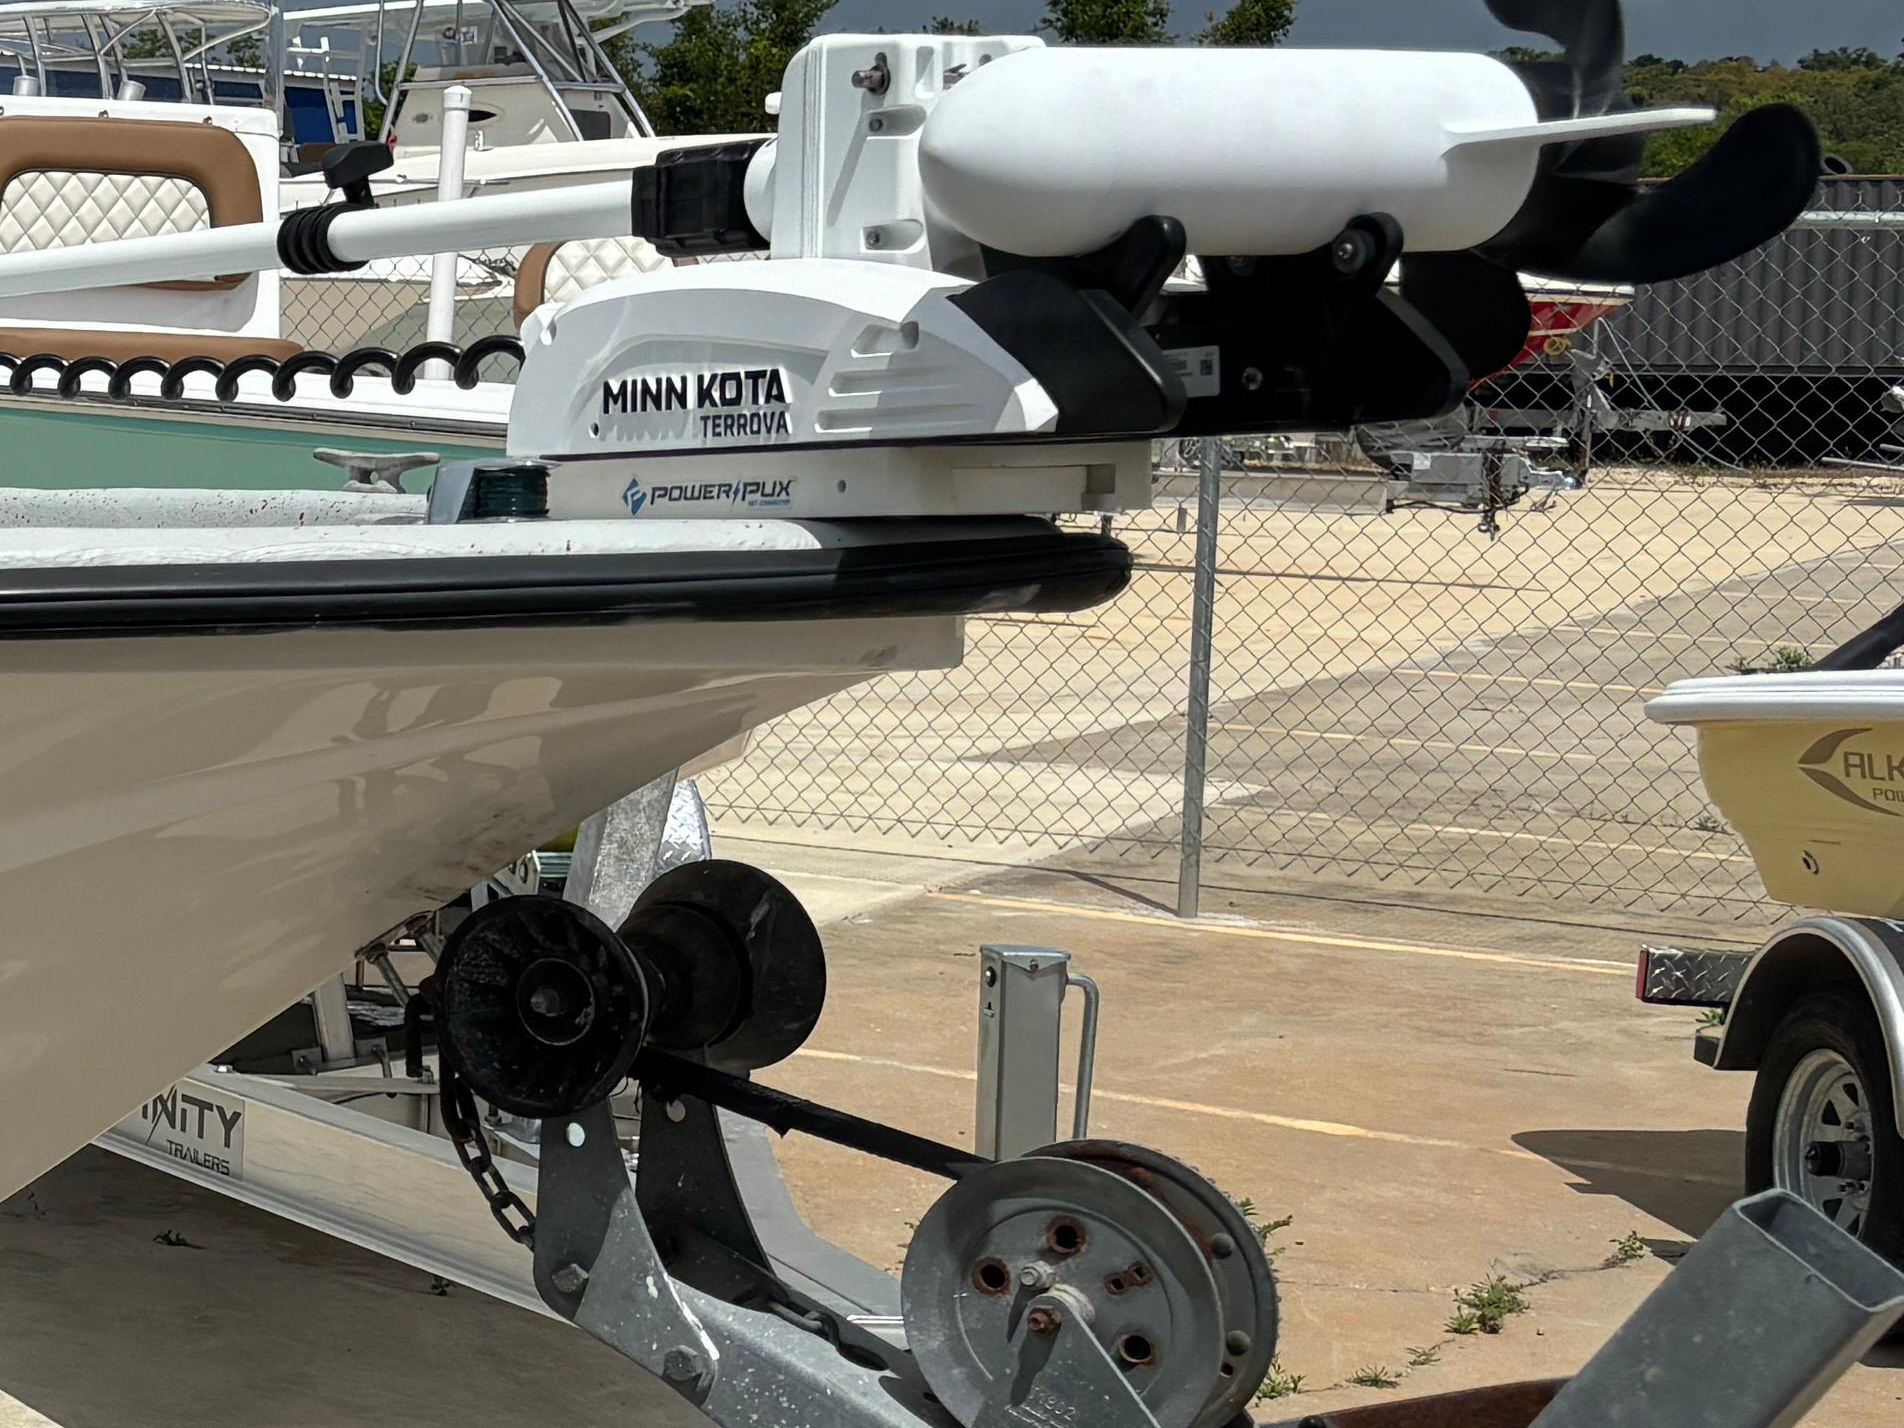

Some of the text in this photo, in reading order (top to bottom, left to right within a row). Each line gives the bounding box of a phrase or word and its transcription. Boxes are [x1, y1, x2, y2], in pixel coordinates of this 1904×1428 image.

[603, 368, 786, 415] MINN KOTA
[700, 411, 789, 439] TERROVA
[166, 1139, 230, 1176] TRAILERS
